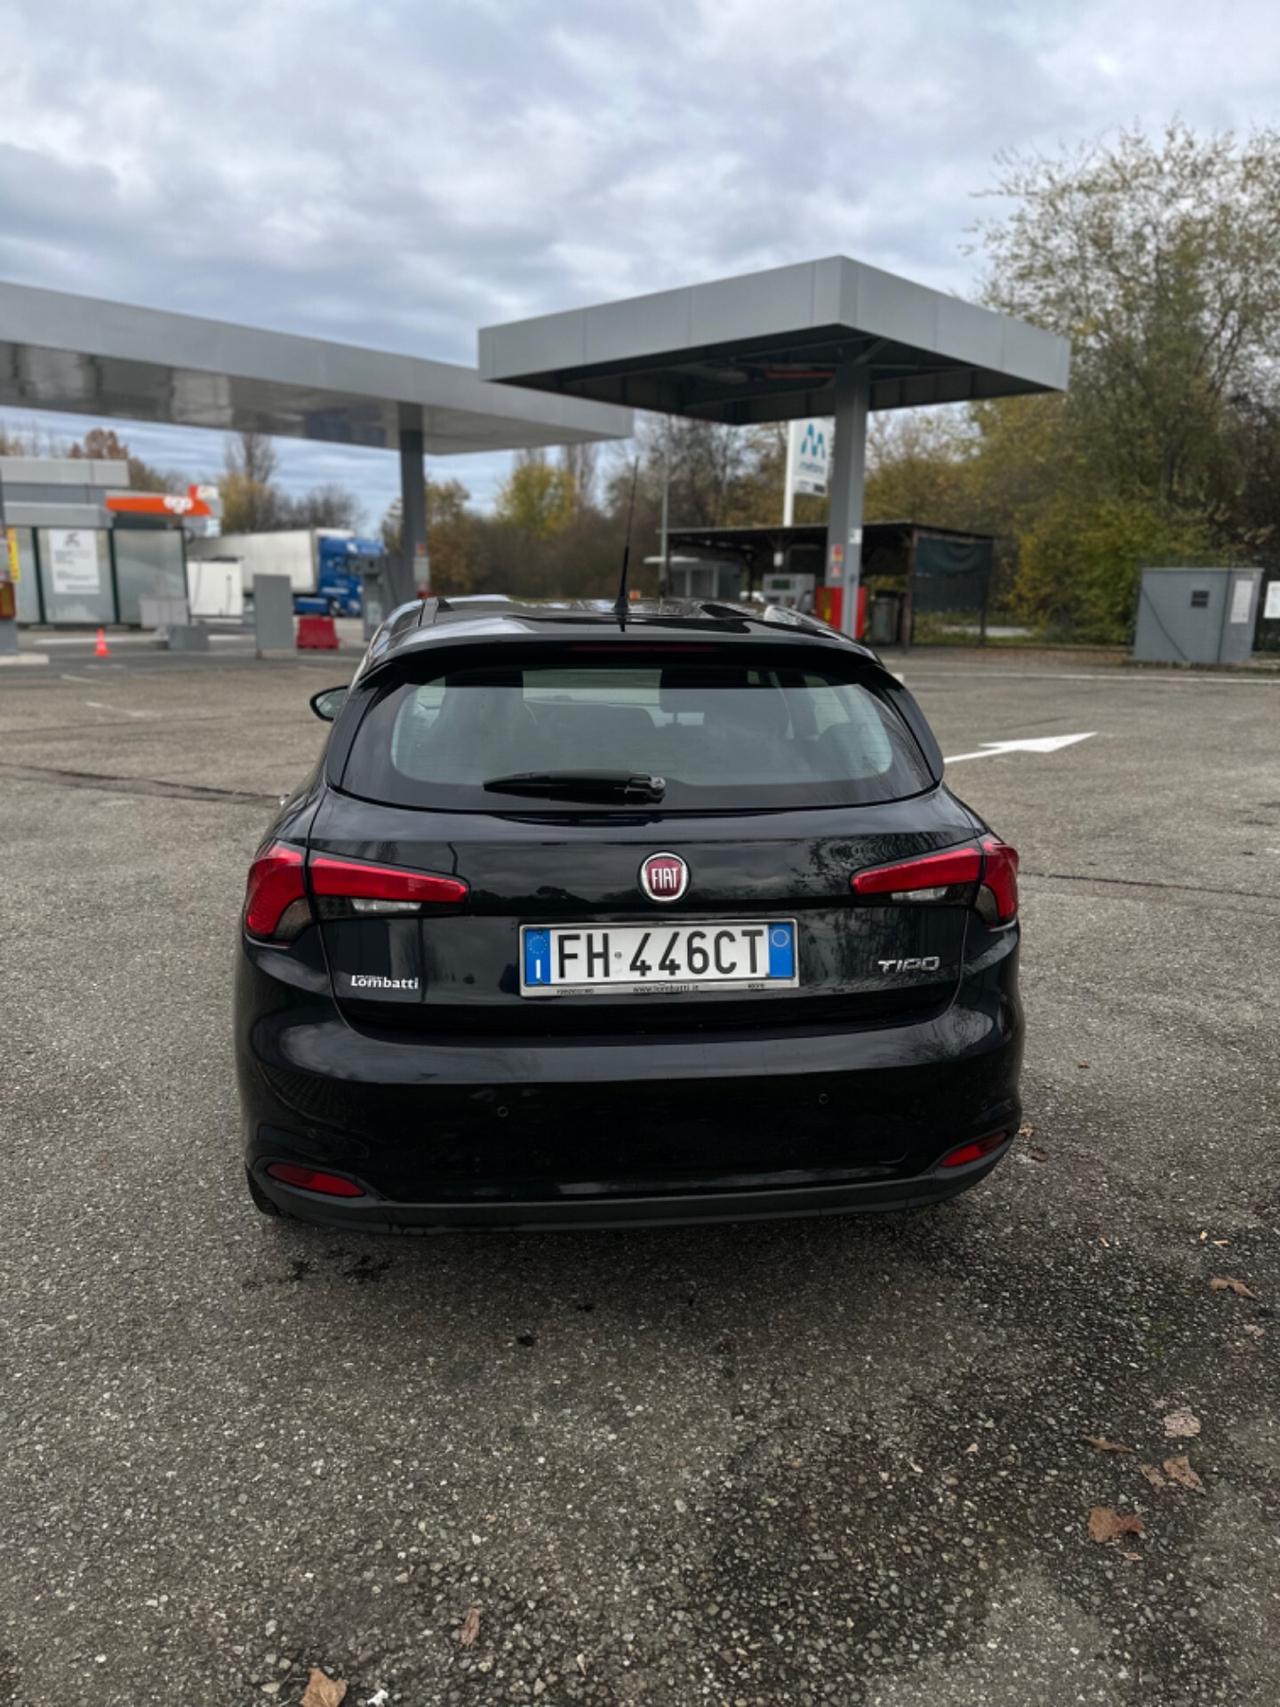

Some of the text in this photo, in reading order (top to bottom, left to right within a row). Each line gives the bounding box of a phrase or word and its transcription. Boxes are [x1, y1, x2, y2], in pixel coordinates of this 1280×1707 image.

[651, 866, 679, 890] FIAT
[557, 929, 764, 979] FH 446CT
[877, 956, 940, 975] TIPO
[350, 974, 419, 990] Lombatti
